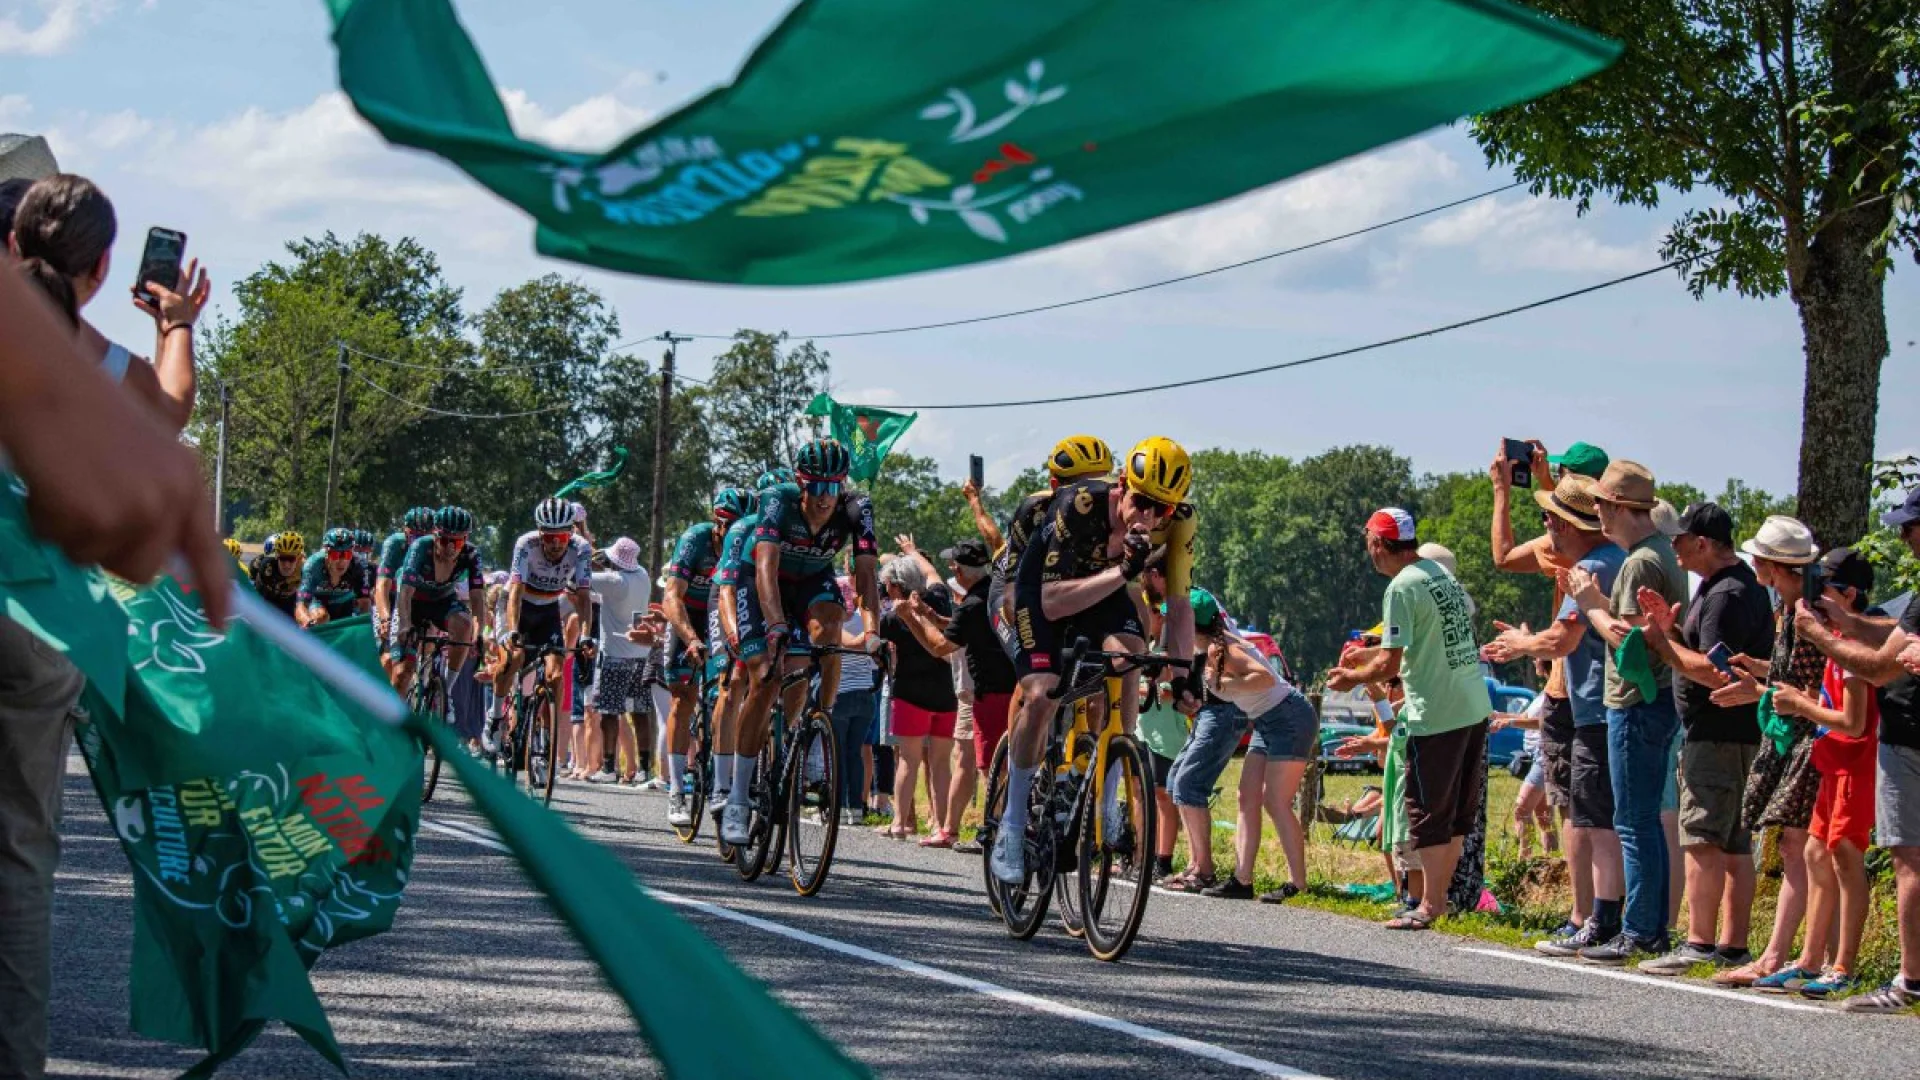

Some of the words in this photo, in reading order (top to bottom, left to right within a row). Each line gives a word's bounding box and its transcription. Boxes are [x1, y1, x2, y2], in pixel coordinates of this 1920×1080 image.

[708, 609, 724, 656] BORA
[736, 586, 753, 641] BORA
[1016, 606, 1036, 649] JUMBO
[336, 773, 386, 813] MA
[278, 812, 334, 858] MON
[297, 771, 392, 866] NATURE
